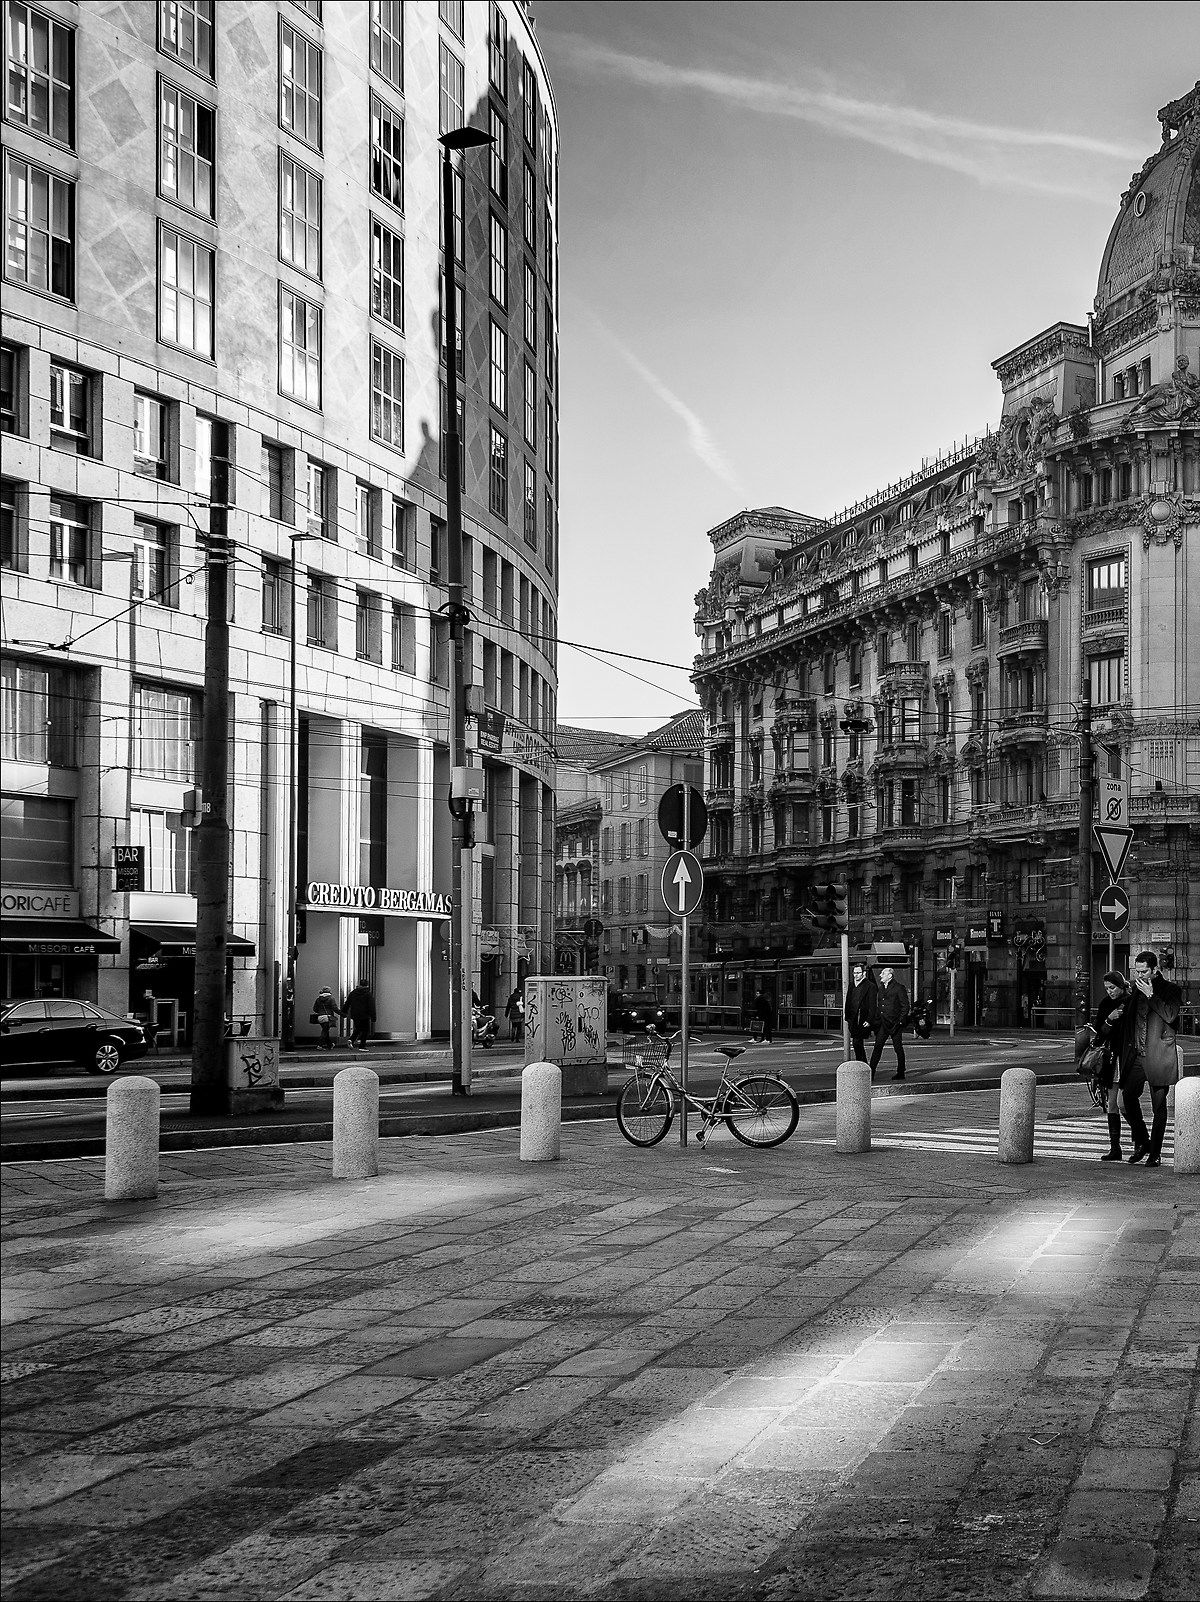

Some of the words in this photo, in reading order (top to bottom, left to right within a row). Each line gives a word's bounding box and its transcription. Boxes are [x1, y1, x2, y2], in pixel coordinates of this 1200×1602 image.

[1106, 782, 1122, 792] zona
[117, 848, 139, 862] BAR
[118, 867, 139, 875] MISSORI
[1, 894, 71, 912] ORICAFÈ
[307, 881, 376, 908] CREDITO
[378, 888, 453, 914] BERGAMAS
[28, 944, 71, 953] MISSORI
[73, 945, 96, 953] CAFÈ
